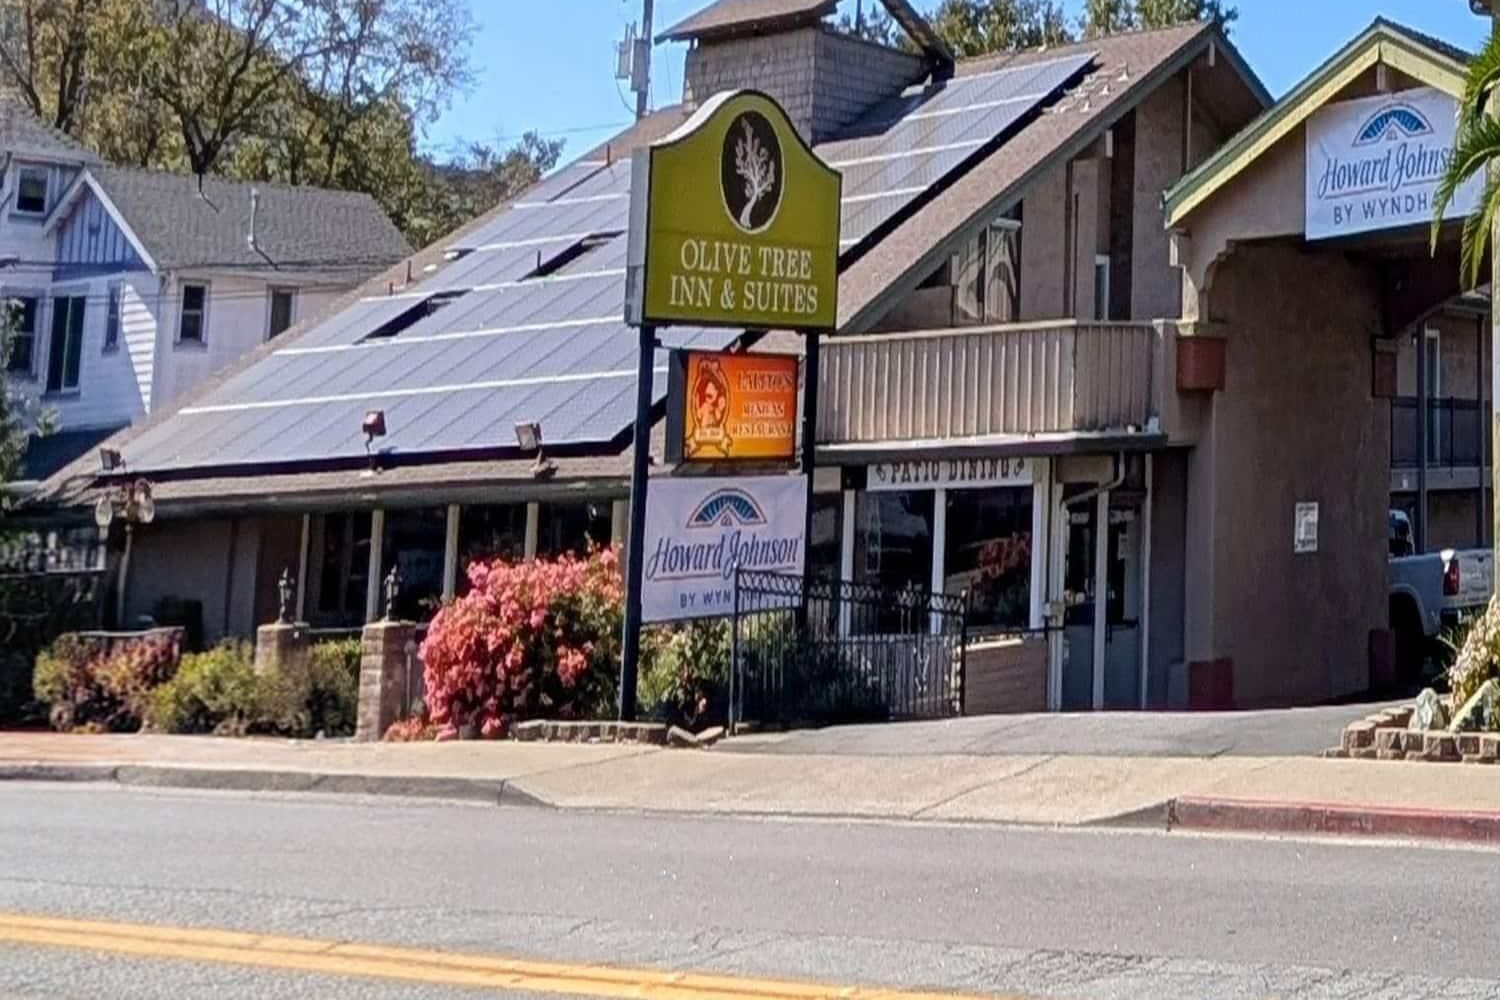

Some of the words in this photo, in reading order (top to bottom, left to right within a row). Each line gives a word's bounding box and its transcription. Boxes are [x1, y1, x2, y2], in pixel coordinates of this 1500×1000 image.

[1318, 149, 1391, 199] Howard
[1334, 206, 1353, 225] BY
[1362, 193, 1430, 220] WYNDH
[681, 238, 751, 276] OLIVE
[759, 246, 812, 280] TREE
[669, 275, 713, 308] INN
[720, 278, 736, 310] &
[743, 281, 818, 314] SUITES
[646, 532, 726, 580] Howard
[722, 529, 800, 581] Johnson
[680, 591, 697, 609] BY
